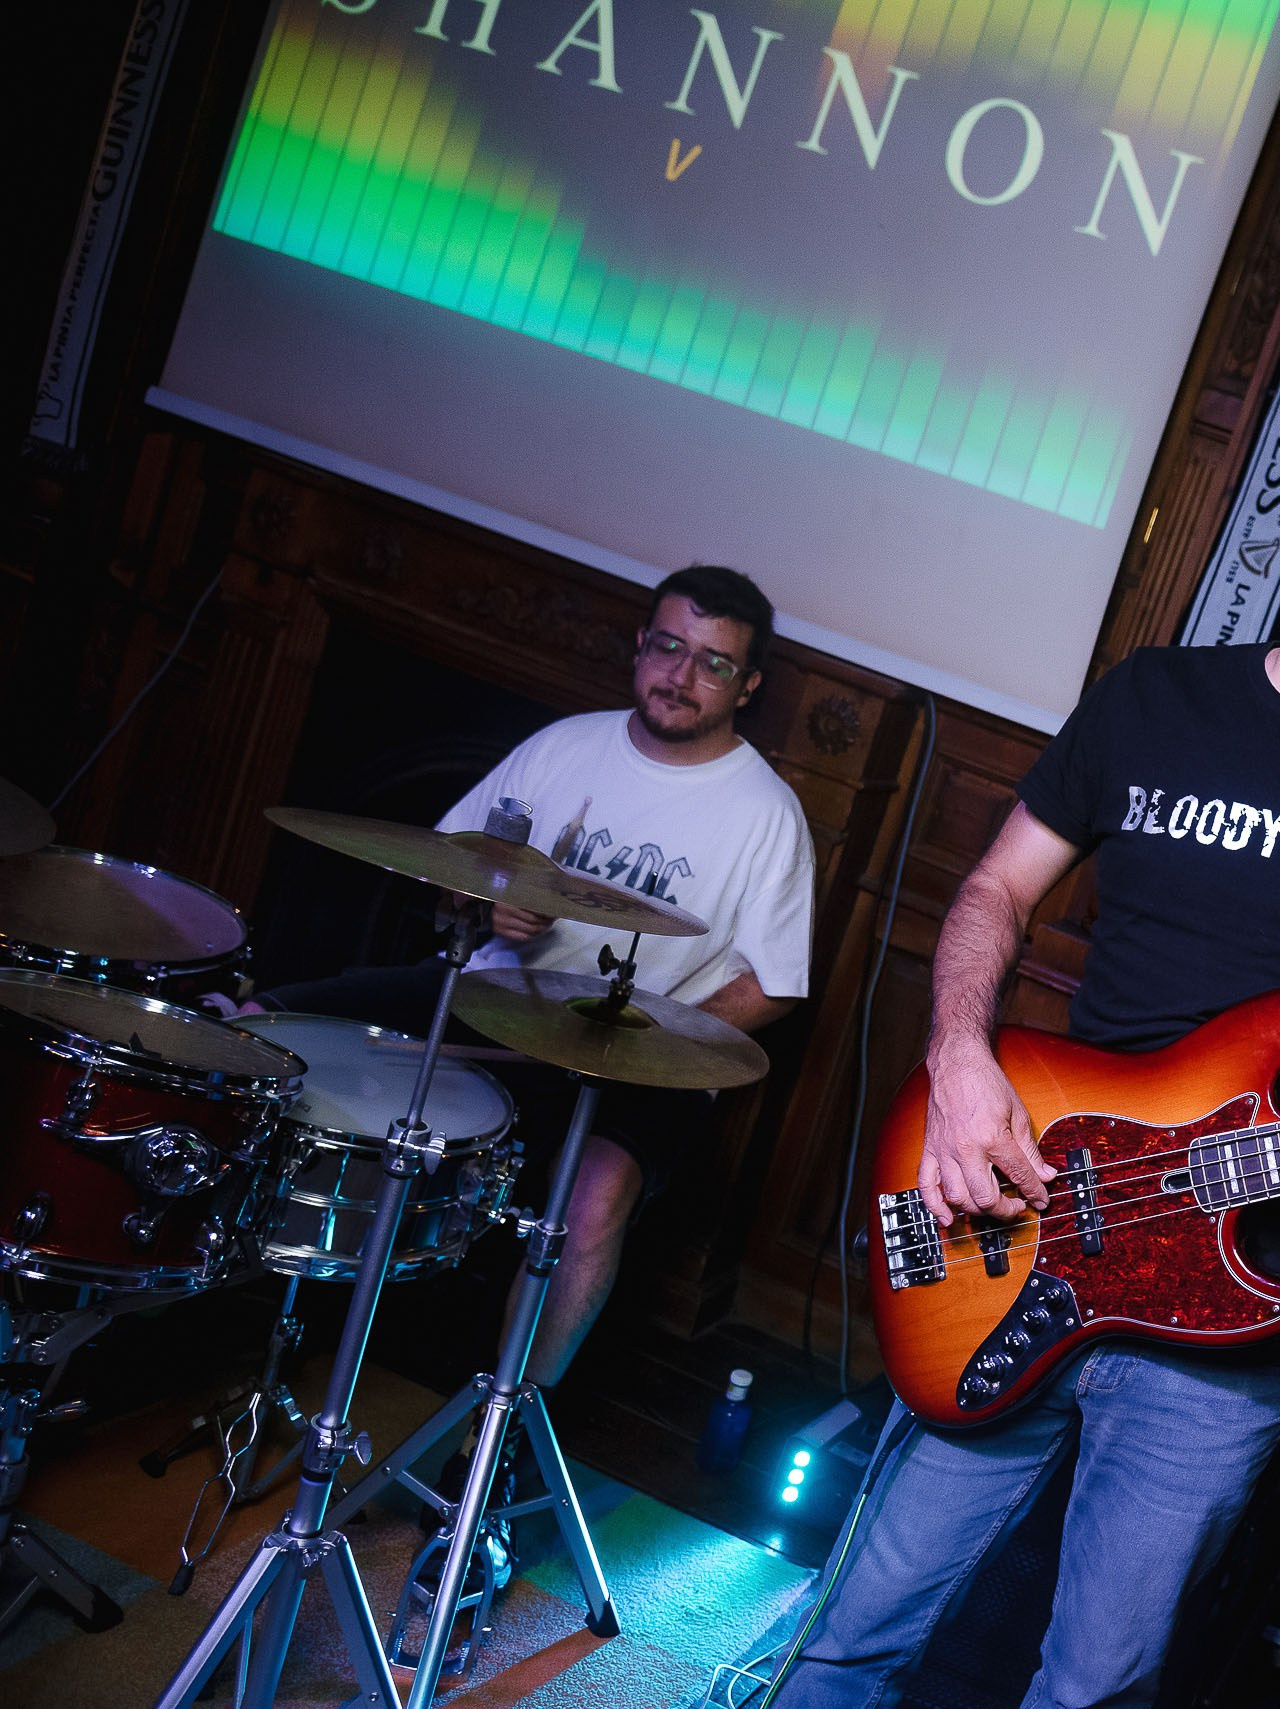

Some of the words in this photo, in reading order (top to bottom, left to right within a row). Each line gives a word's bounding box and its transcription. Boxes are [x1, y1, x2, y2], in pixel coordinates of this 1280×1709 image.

[69, 204, 102, 303] PERFECTA
[91, 0, 166, 201] GUINNESS
[323, 0, 1205, 257] ANNON
[1230, 584, 1251, 606] LA
